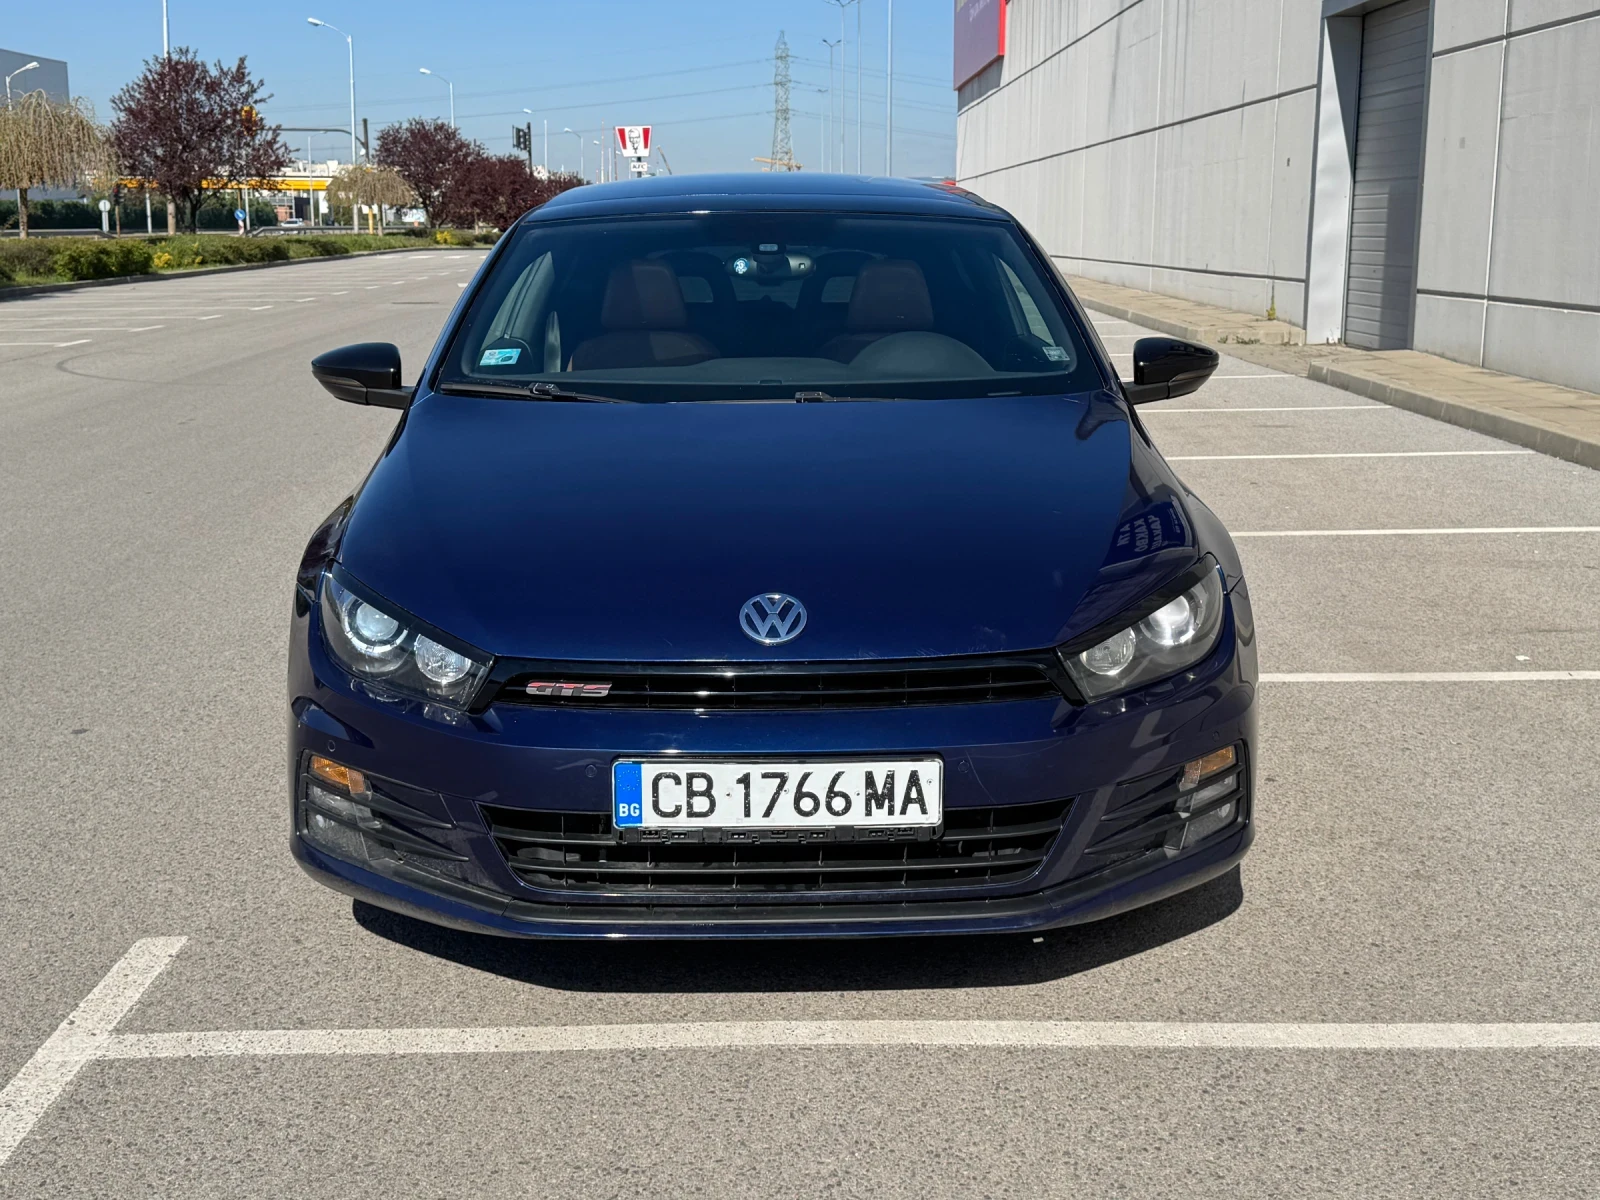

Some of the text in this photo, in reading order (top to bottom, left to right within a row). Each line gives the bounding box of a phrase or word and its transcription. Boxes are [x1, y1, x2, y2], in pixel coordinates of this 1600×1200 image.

[526, 682, 612, 697] GTS
[651, 769, 929, 818] CB 1766 MA
[619, 803, 640, 817] BG
